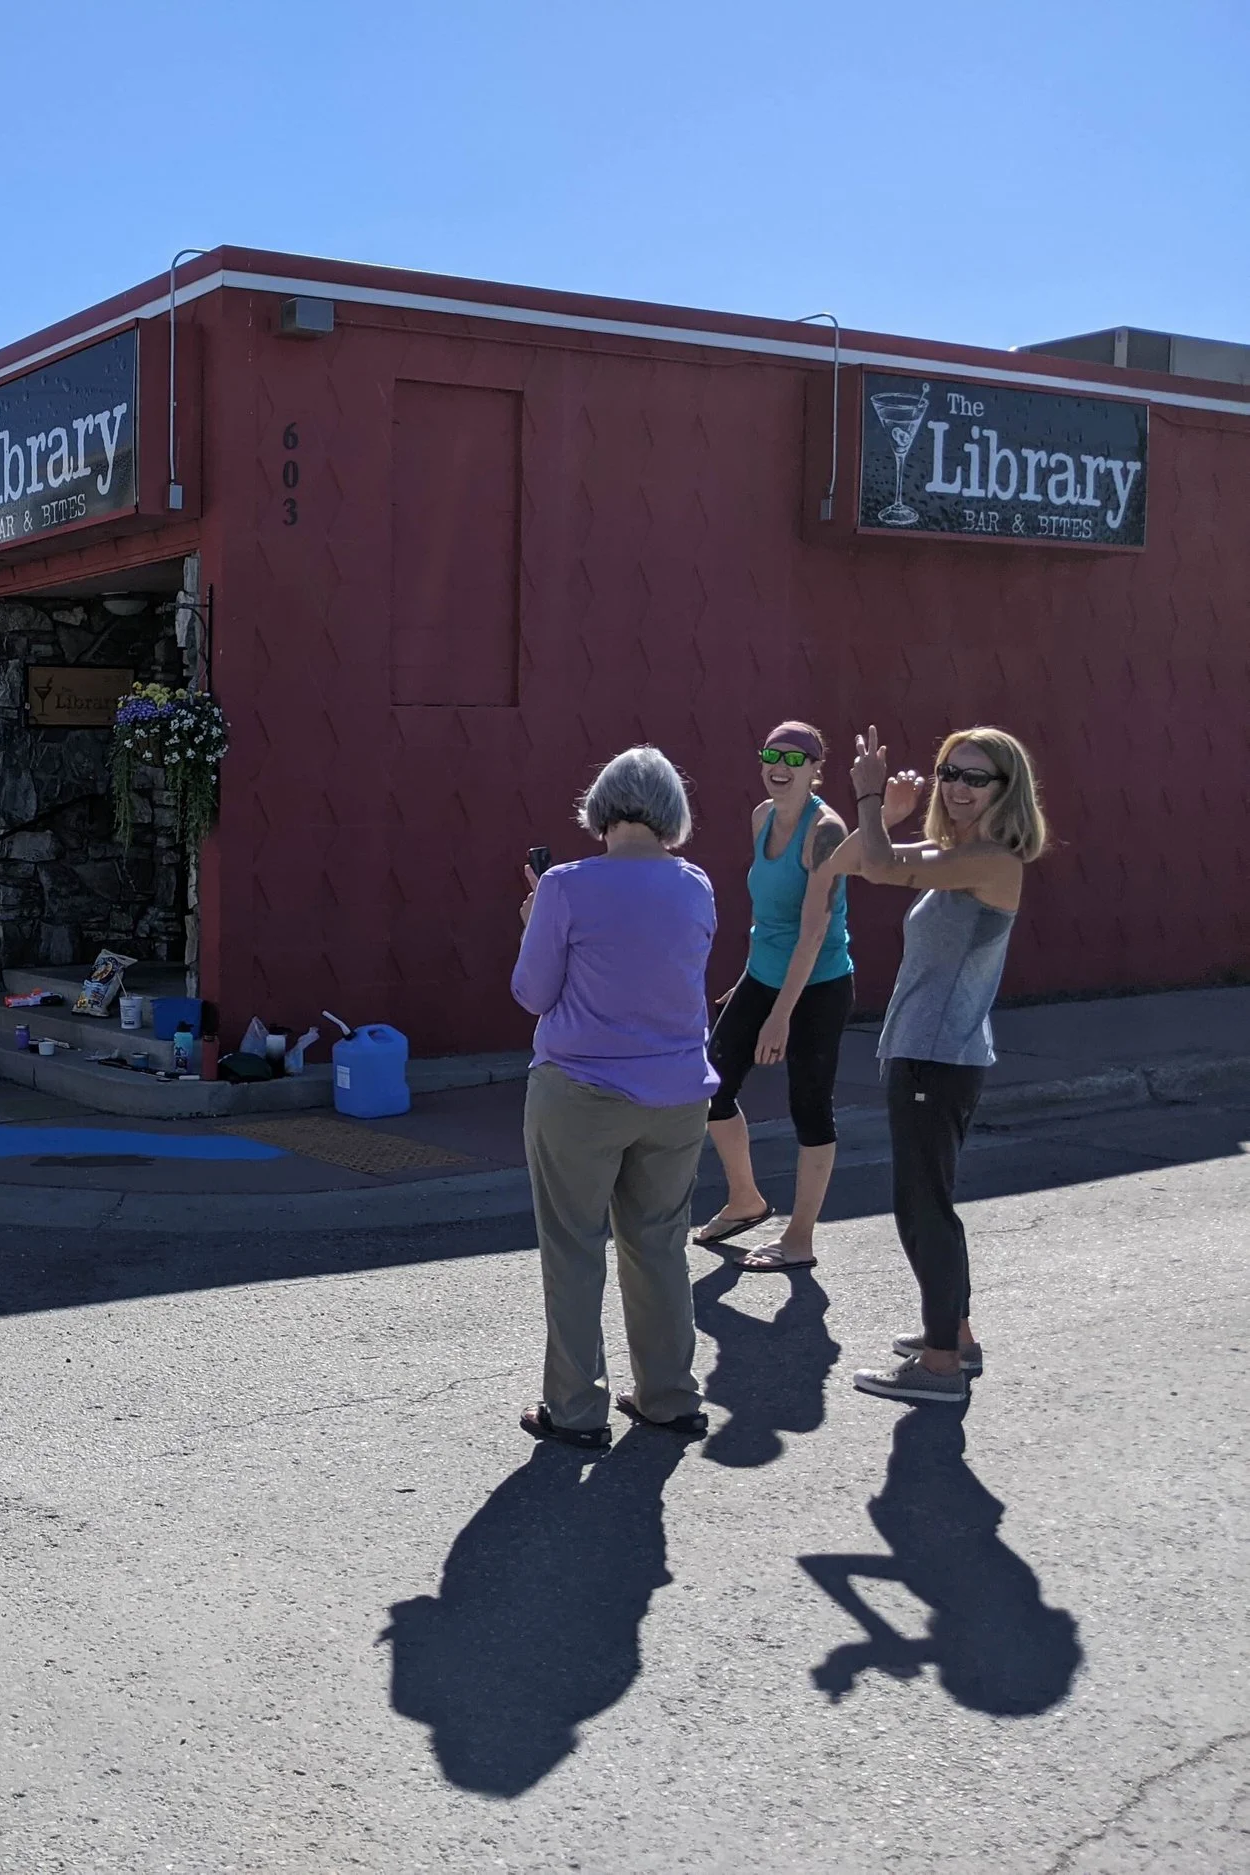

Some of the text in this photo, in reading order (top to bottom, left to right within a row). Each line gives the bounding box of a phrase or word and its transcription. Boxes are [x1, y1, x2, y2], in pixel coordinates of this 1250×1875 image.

[946, 392, 985, 418] The
[282, 421, 299, 526] 603
[924, 420, 1142, 529] Library
[23, 510, 33, 532] &
[41, 493, 86, 528] BITES
[963, 509, 1092, 539] BAR & BITES
